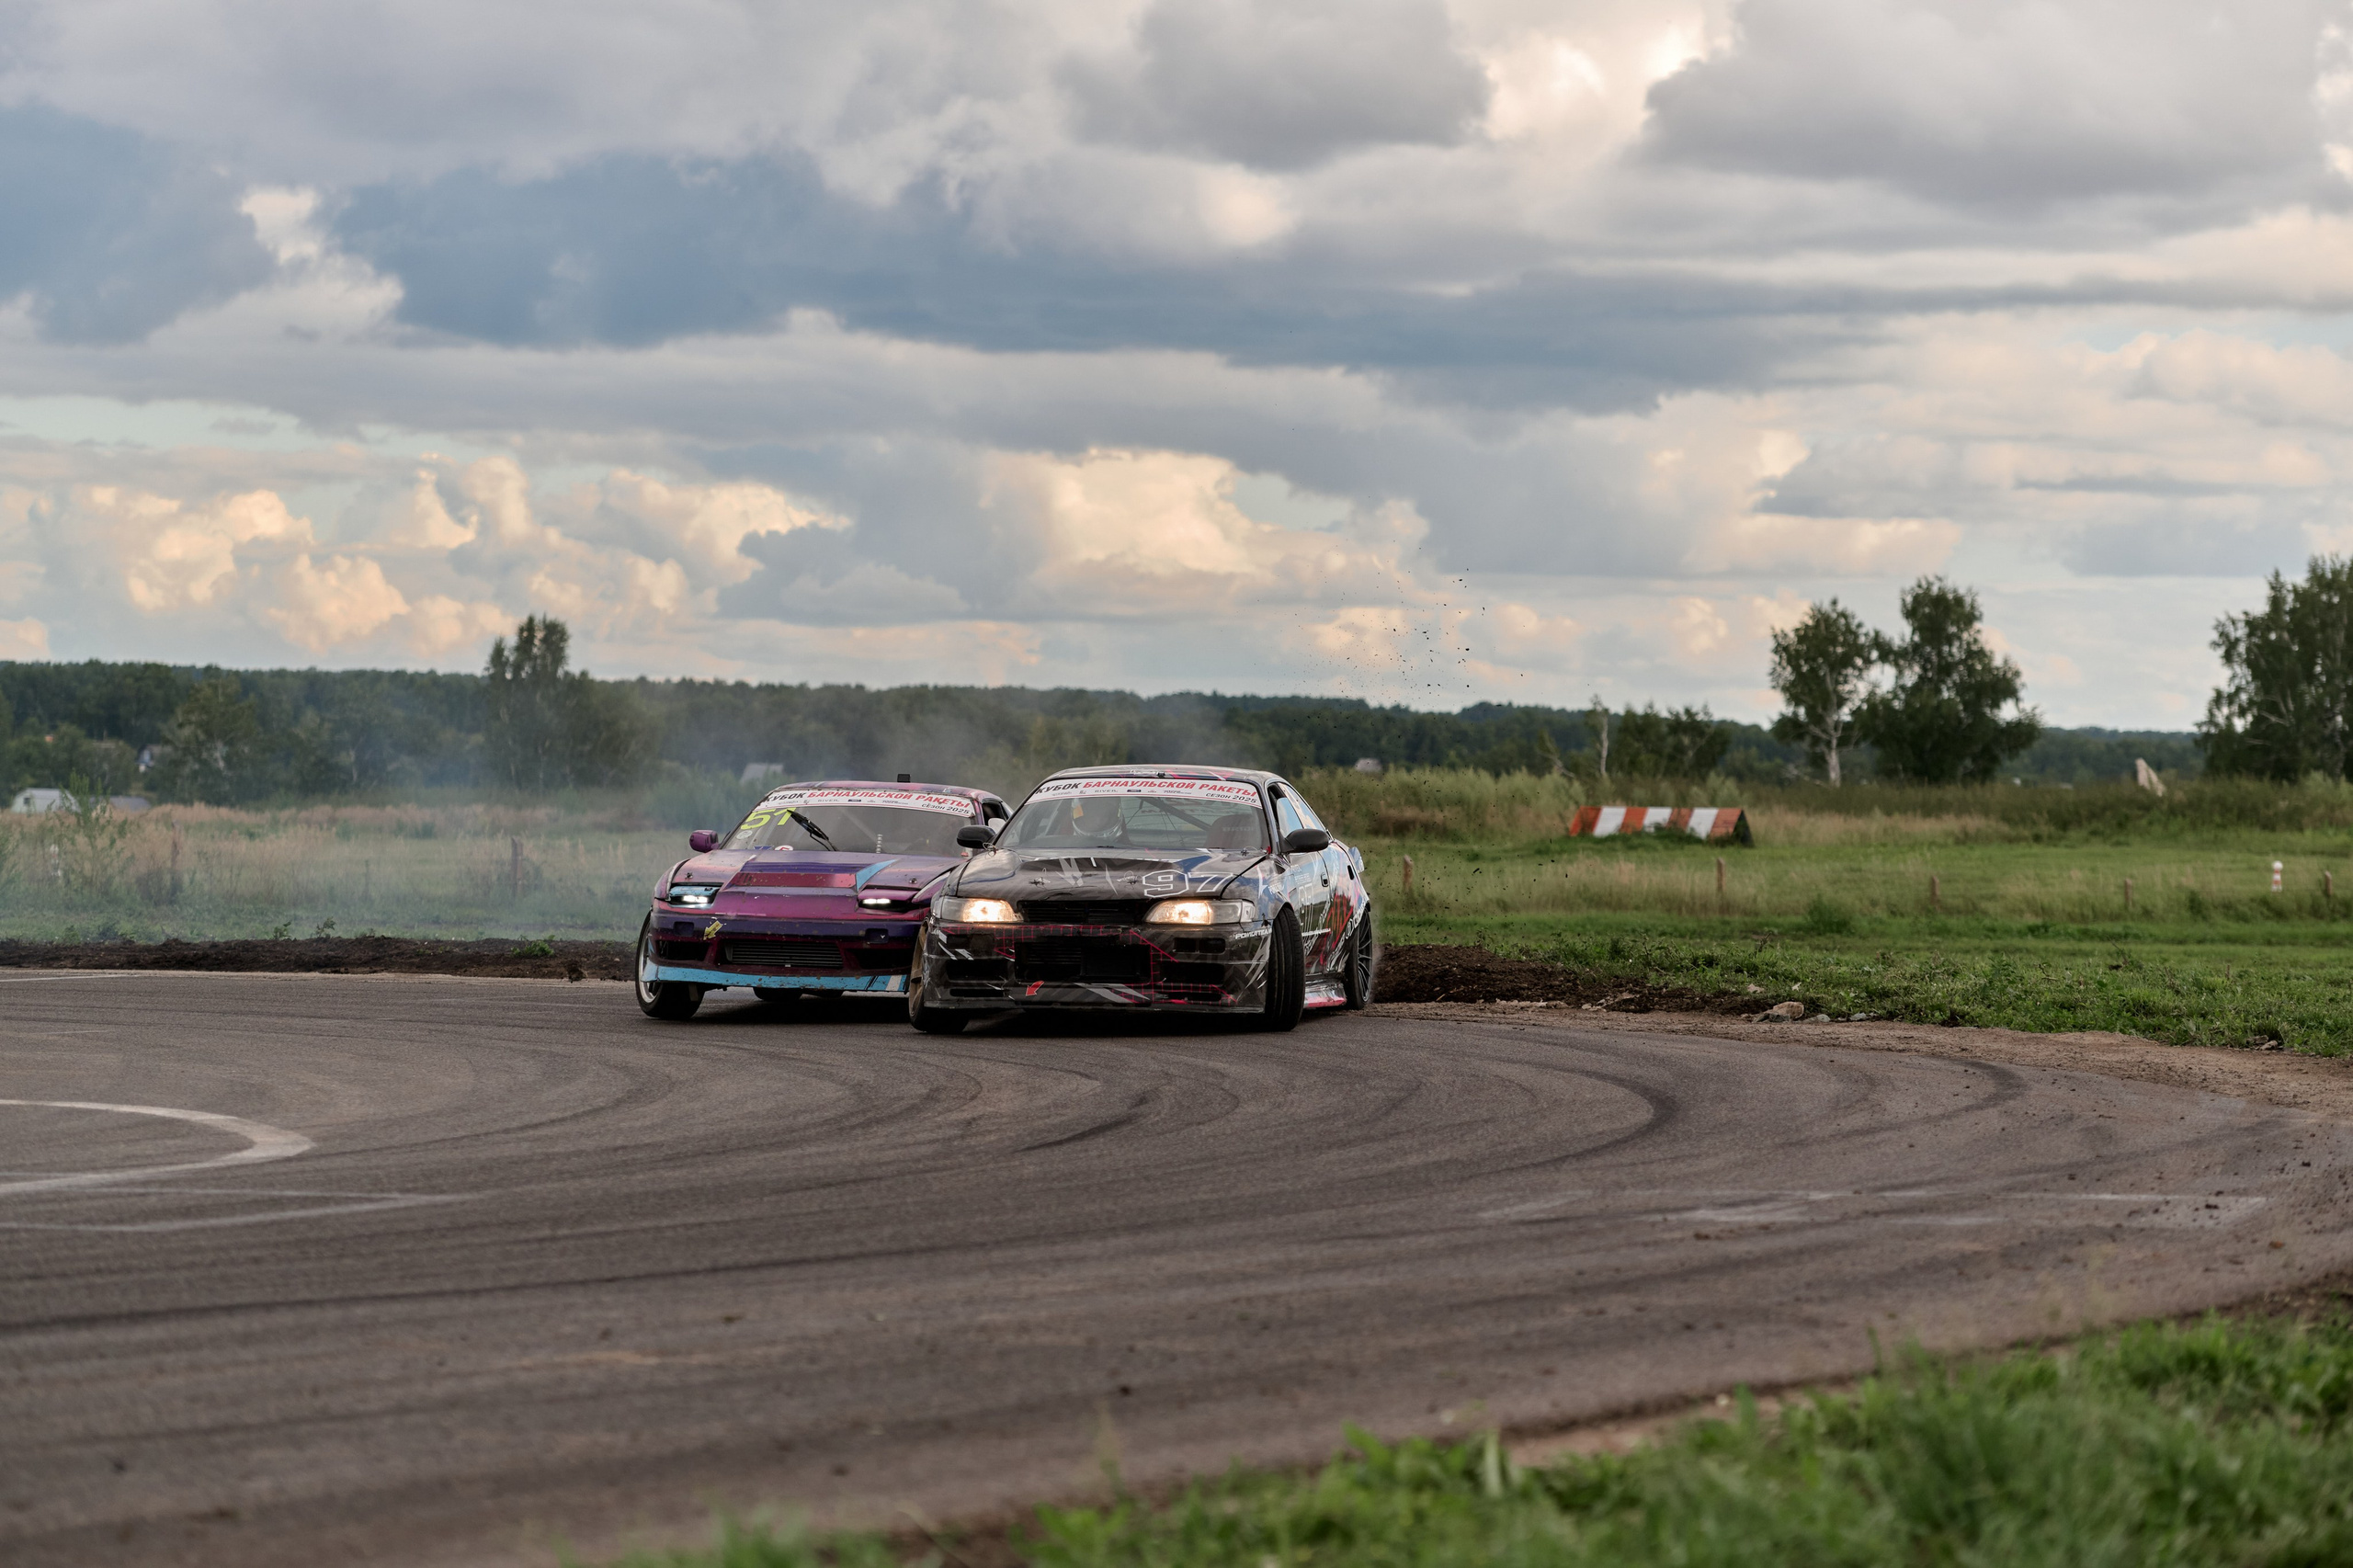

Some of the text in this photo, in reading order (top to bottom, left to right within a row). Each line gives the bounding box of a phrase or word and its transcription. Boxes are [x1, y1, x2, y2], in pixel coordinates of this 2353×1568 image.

[1035, 781, 1256, 797] КУБОК БАРНАУЛЬСКОЙ РАКЕТЫ
[807, 791, 914, 800] БАРНАУЛЬСКОЙ
[915, 794, 971, 808] РАКЕТЫ
[1233, 795, 1256, 803] 2025
[947, 806, 970, 814] 2025
[741, 808, 796, 829] 51
[1142, 869, 1233, 897] 97
